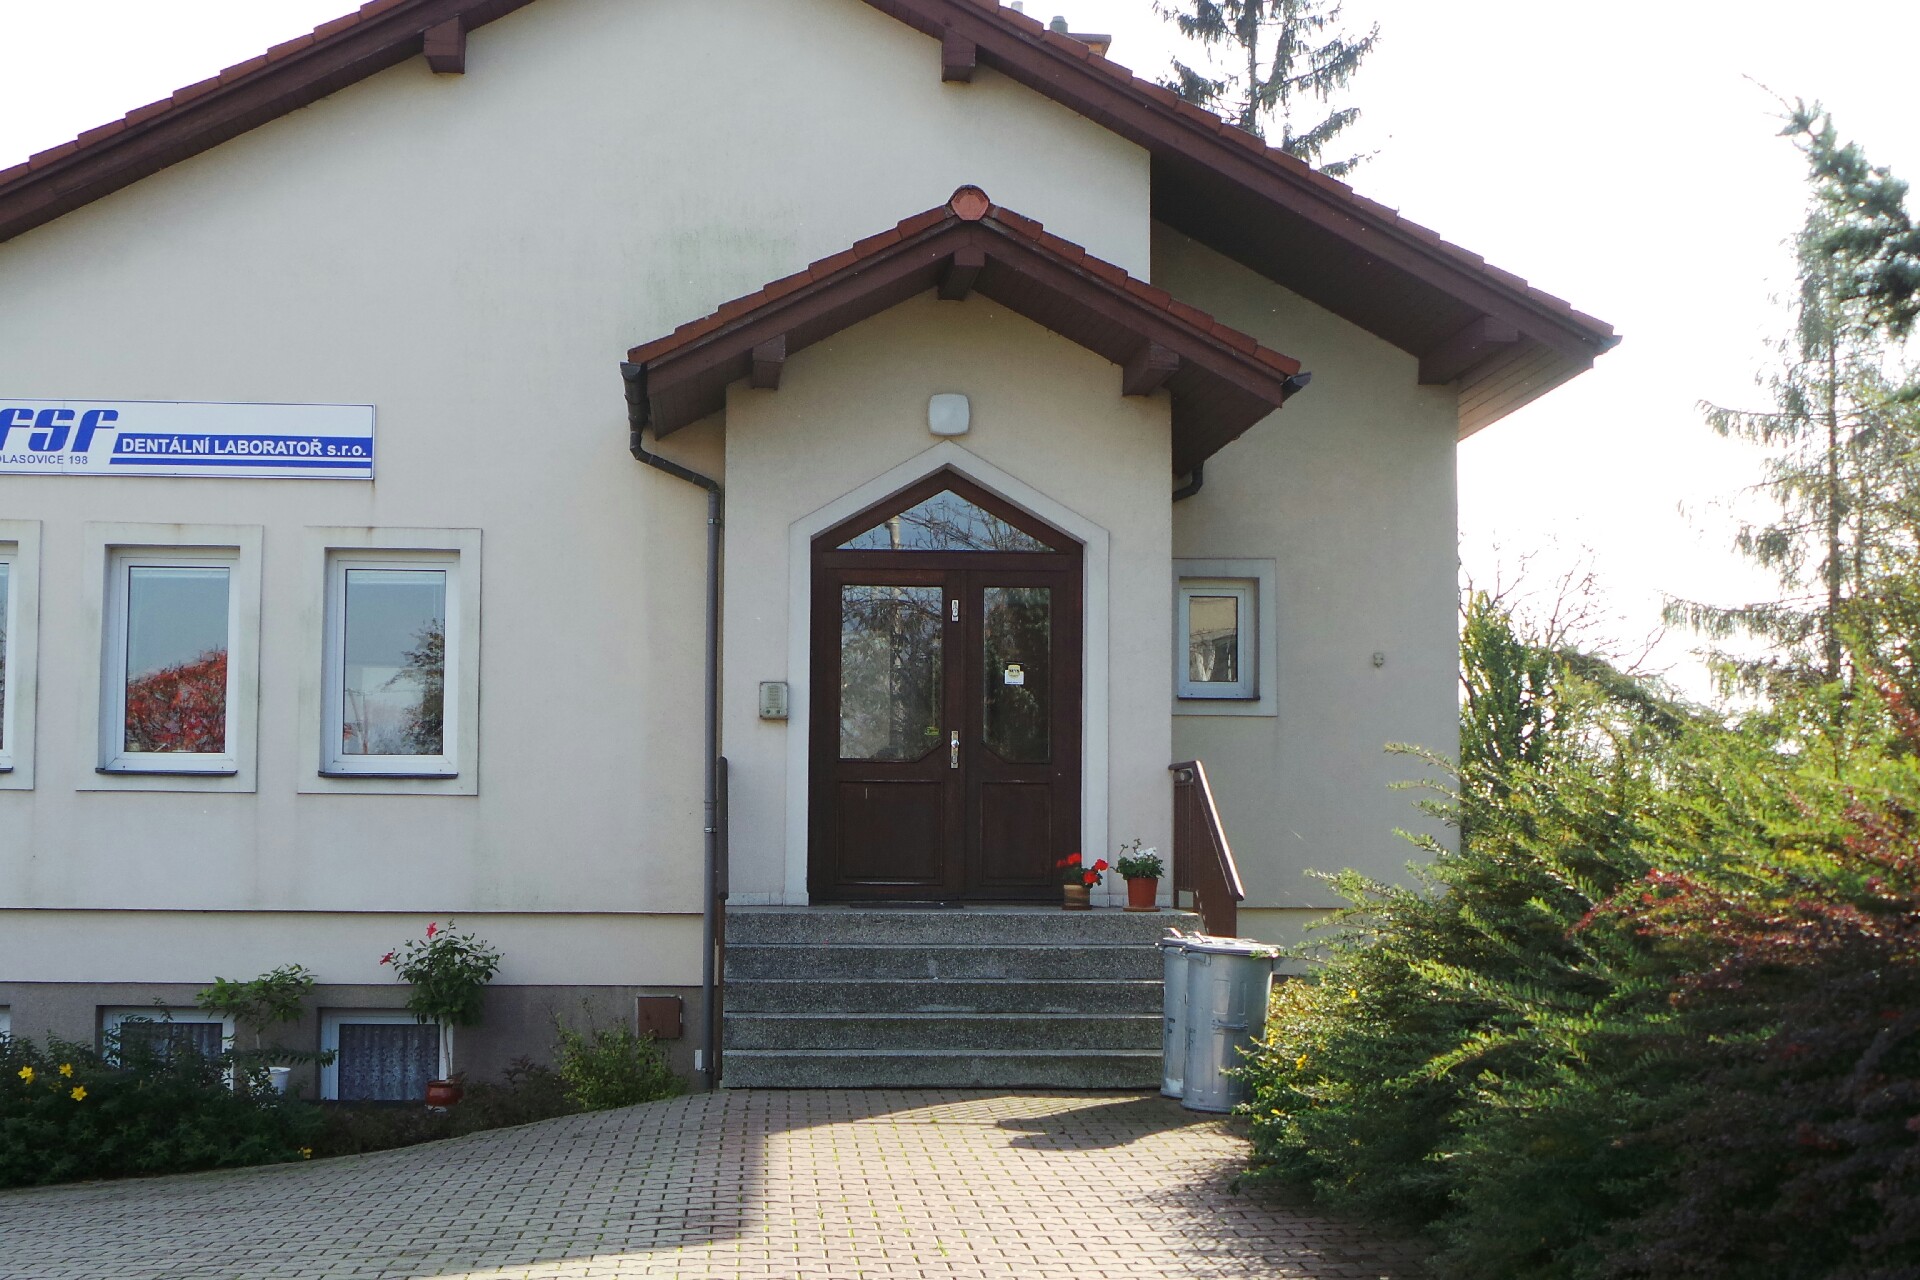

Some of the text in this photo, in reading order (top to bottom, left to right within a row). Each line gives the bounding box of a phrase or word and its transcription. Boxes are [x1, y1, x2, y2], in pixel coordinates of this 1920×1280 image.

[122, 436, 367, 456] DENTÁLNÍ LABORATOŘ s.r.o.
[0, 454, 88, 465] LASOVICE 198
